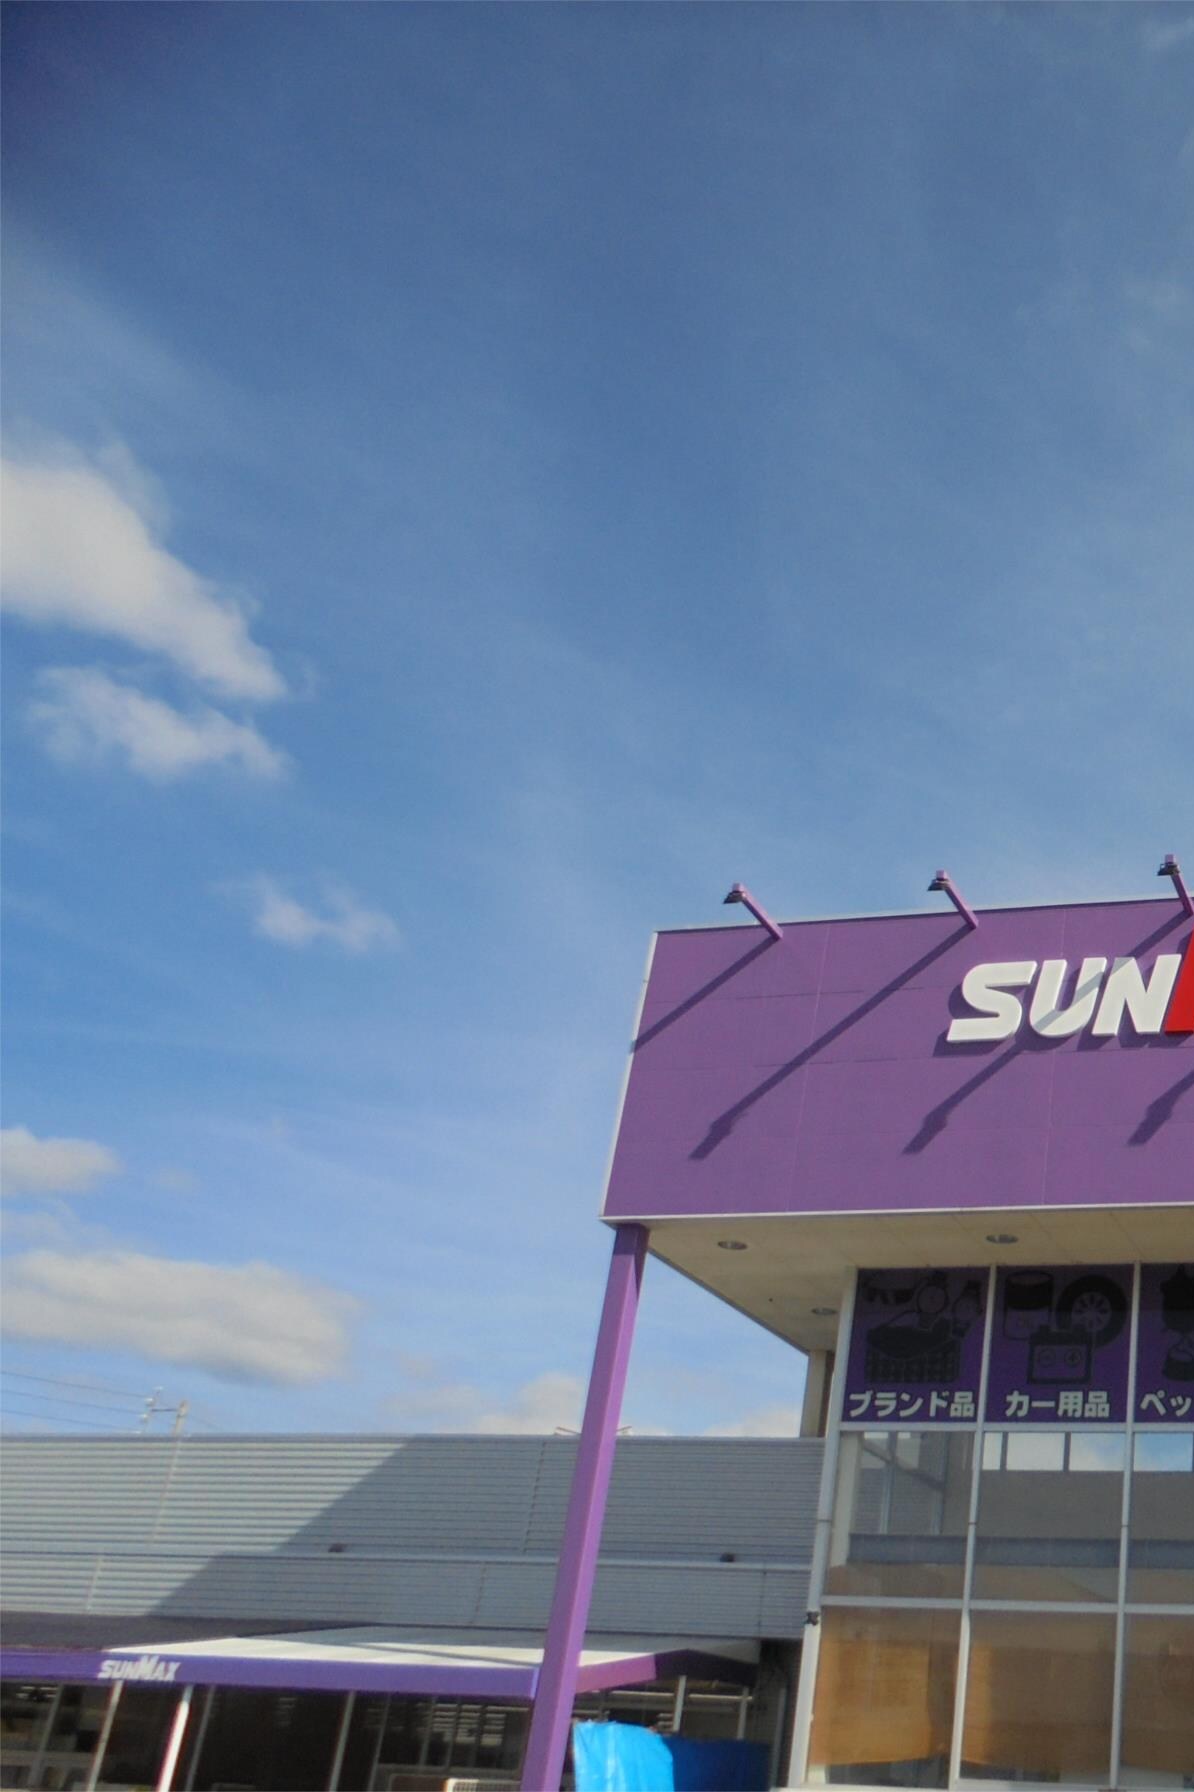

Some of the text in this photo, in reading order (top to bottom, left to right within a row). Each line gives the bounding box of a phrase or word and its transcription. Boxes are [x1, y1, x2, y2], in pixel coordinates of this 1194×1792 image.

[850, 1390, 975, 1418] ブランド品
[1005, 1389, 1110, 1418] カー用品
